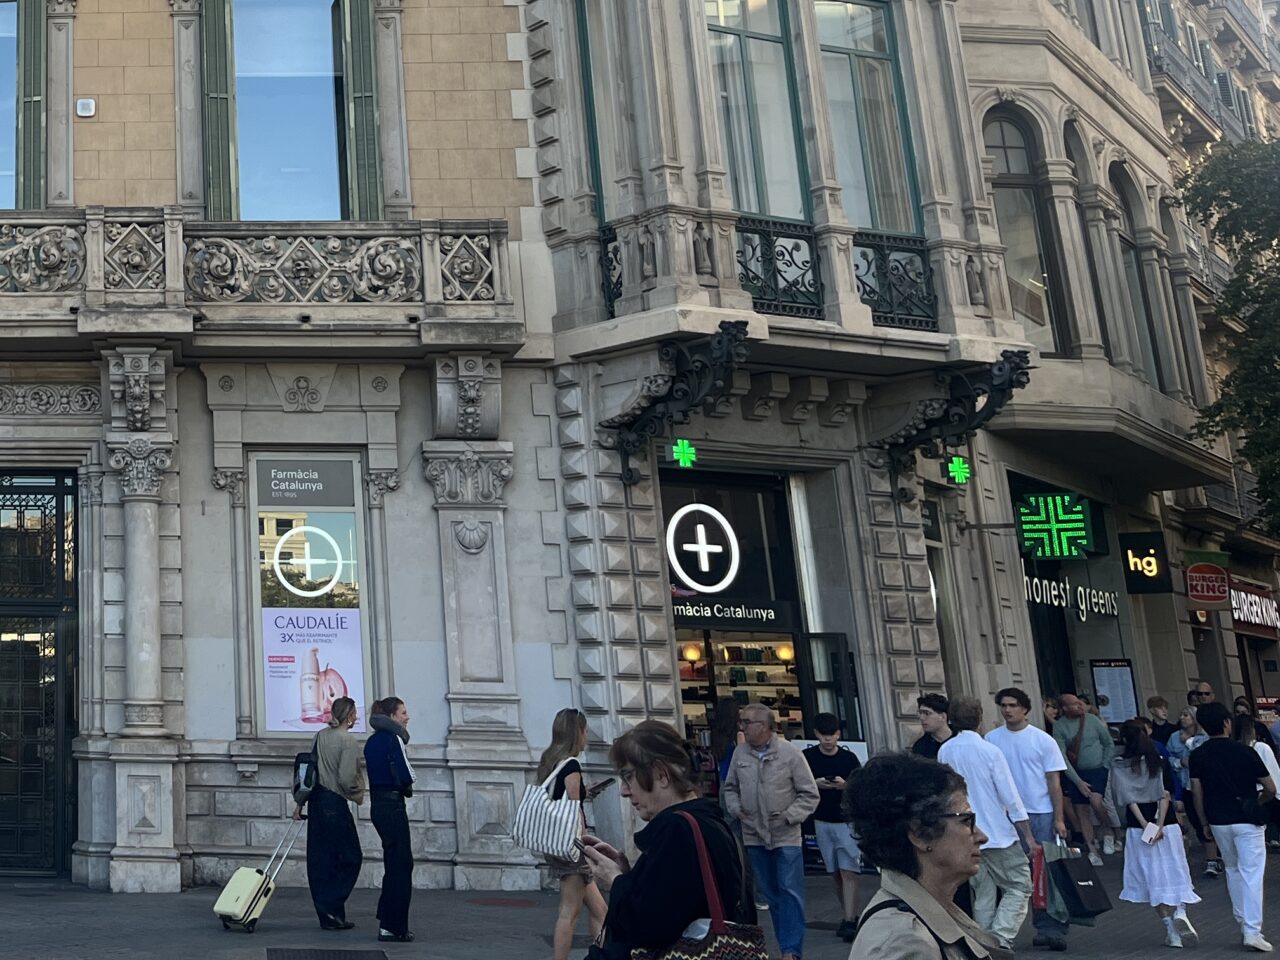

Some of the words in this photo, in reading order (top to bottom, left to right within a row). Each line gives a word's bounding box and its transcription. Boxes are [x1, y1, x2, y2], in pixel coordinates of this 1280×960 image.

[271, 469, 318, 479] Farmàcia
[271, 480, 323, 492] Catalunya
[1188, 574, 1226, 584] BURGER
[1021, 557, 1071, 609] honest
[1077, 585, 1118, 622] greens
[1189, 583, 1227, 595] KING
[714, 604, 775, 621] Catalunya
[1230, 588, 1265, 625] BURGER
[1260, 596, 1280, 629] KING
[280, 632, 295, 643] 3X
